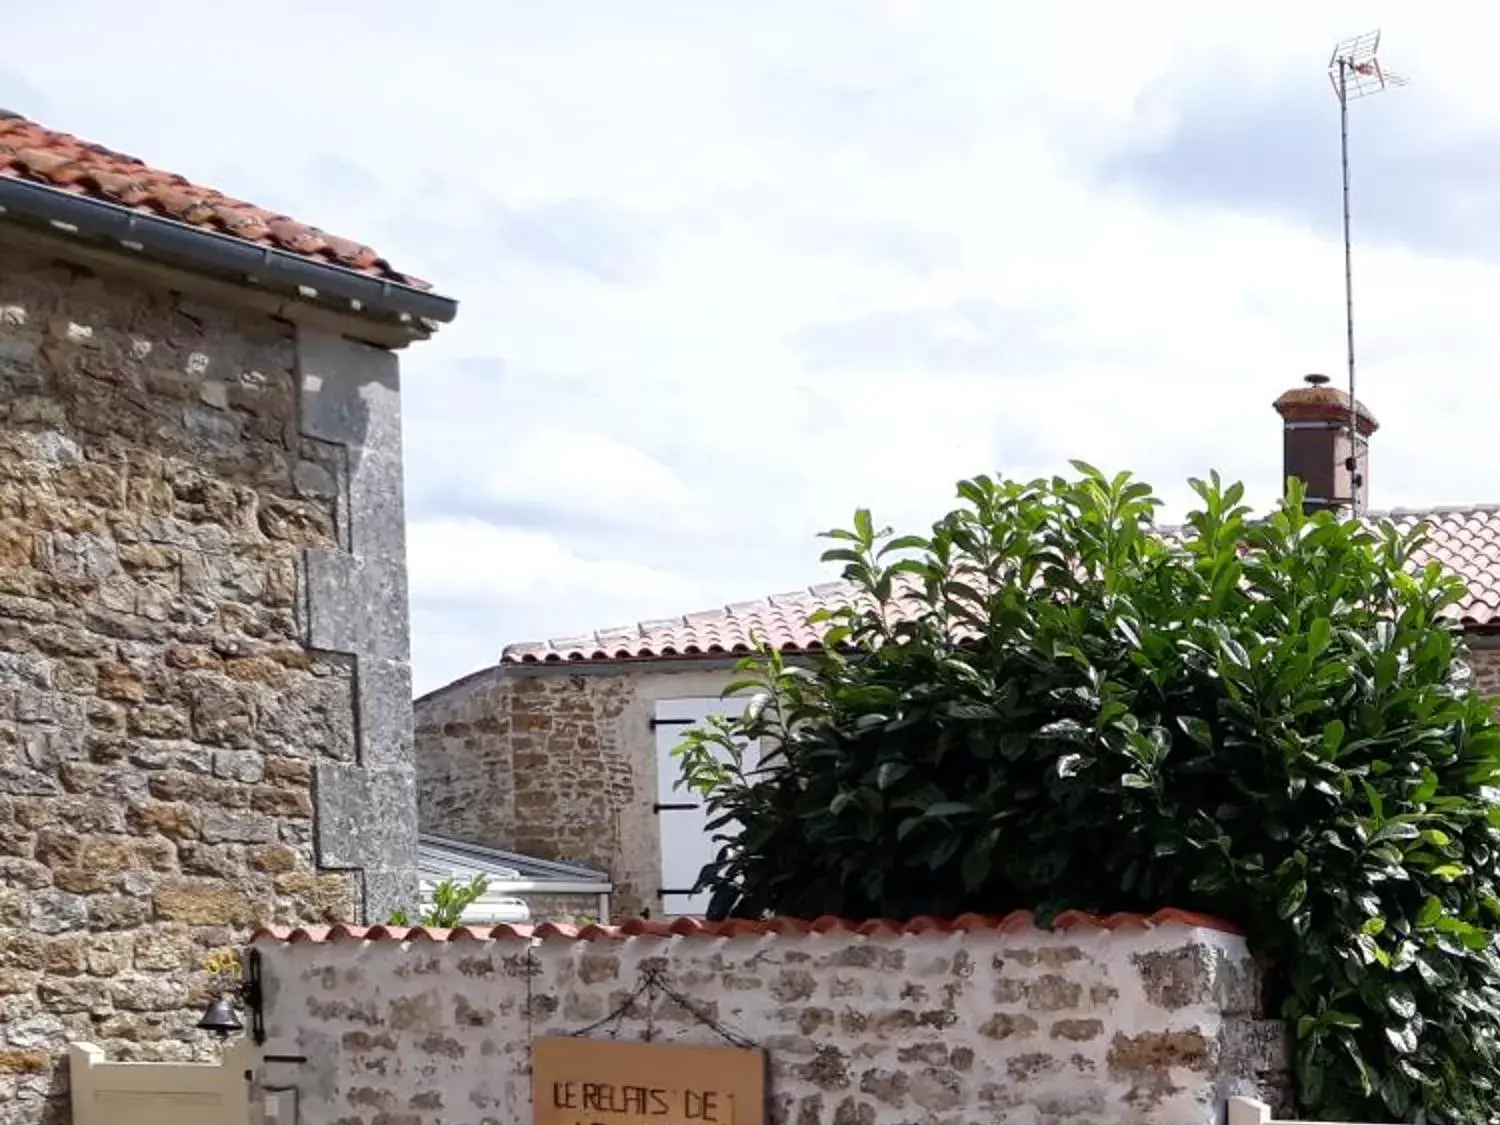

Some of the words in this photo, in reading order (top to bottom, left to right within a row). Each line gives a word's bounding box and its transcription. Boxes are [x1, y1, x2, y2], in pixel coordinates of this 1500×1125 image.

[553, 1081, 577, 1109] LE
[582, 1082, 670, 1115] RELAIS
[684, 1088, 719, 1122] DE
